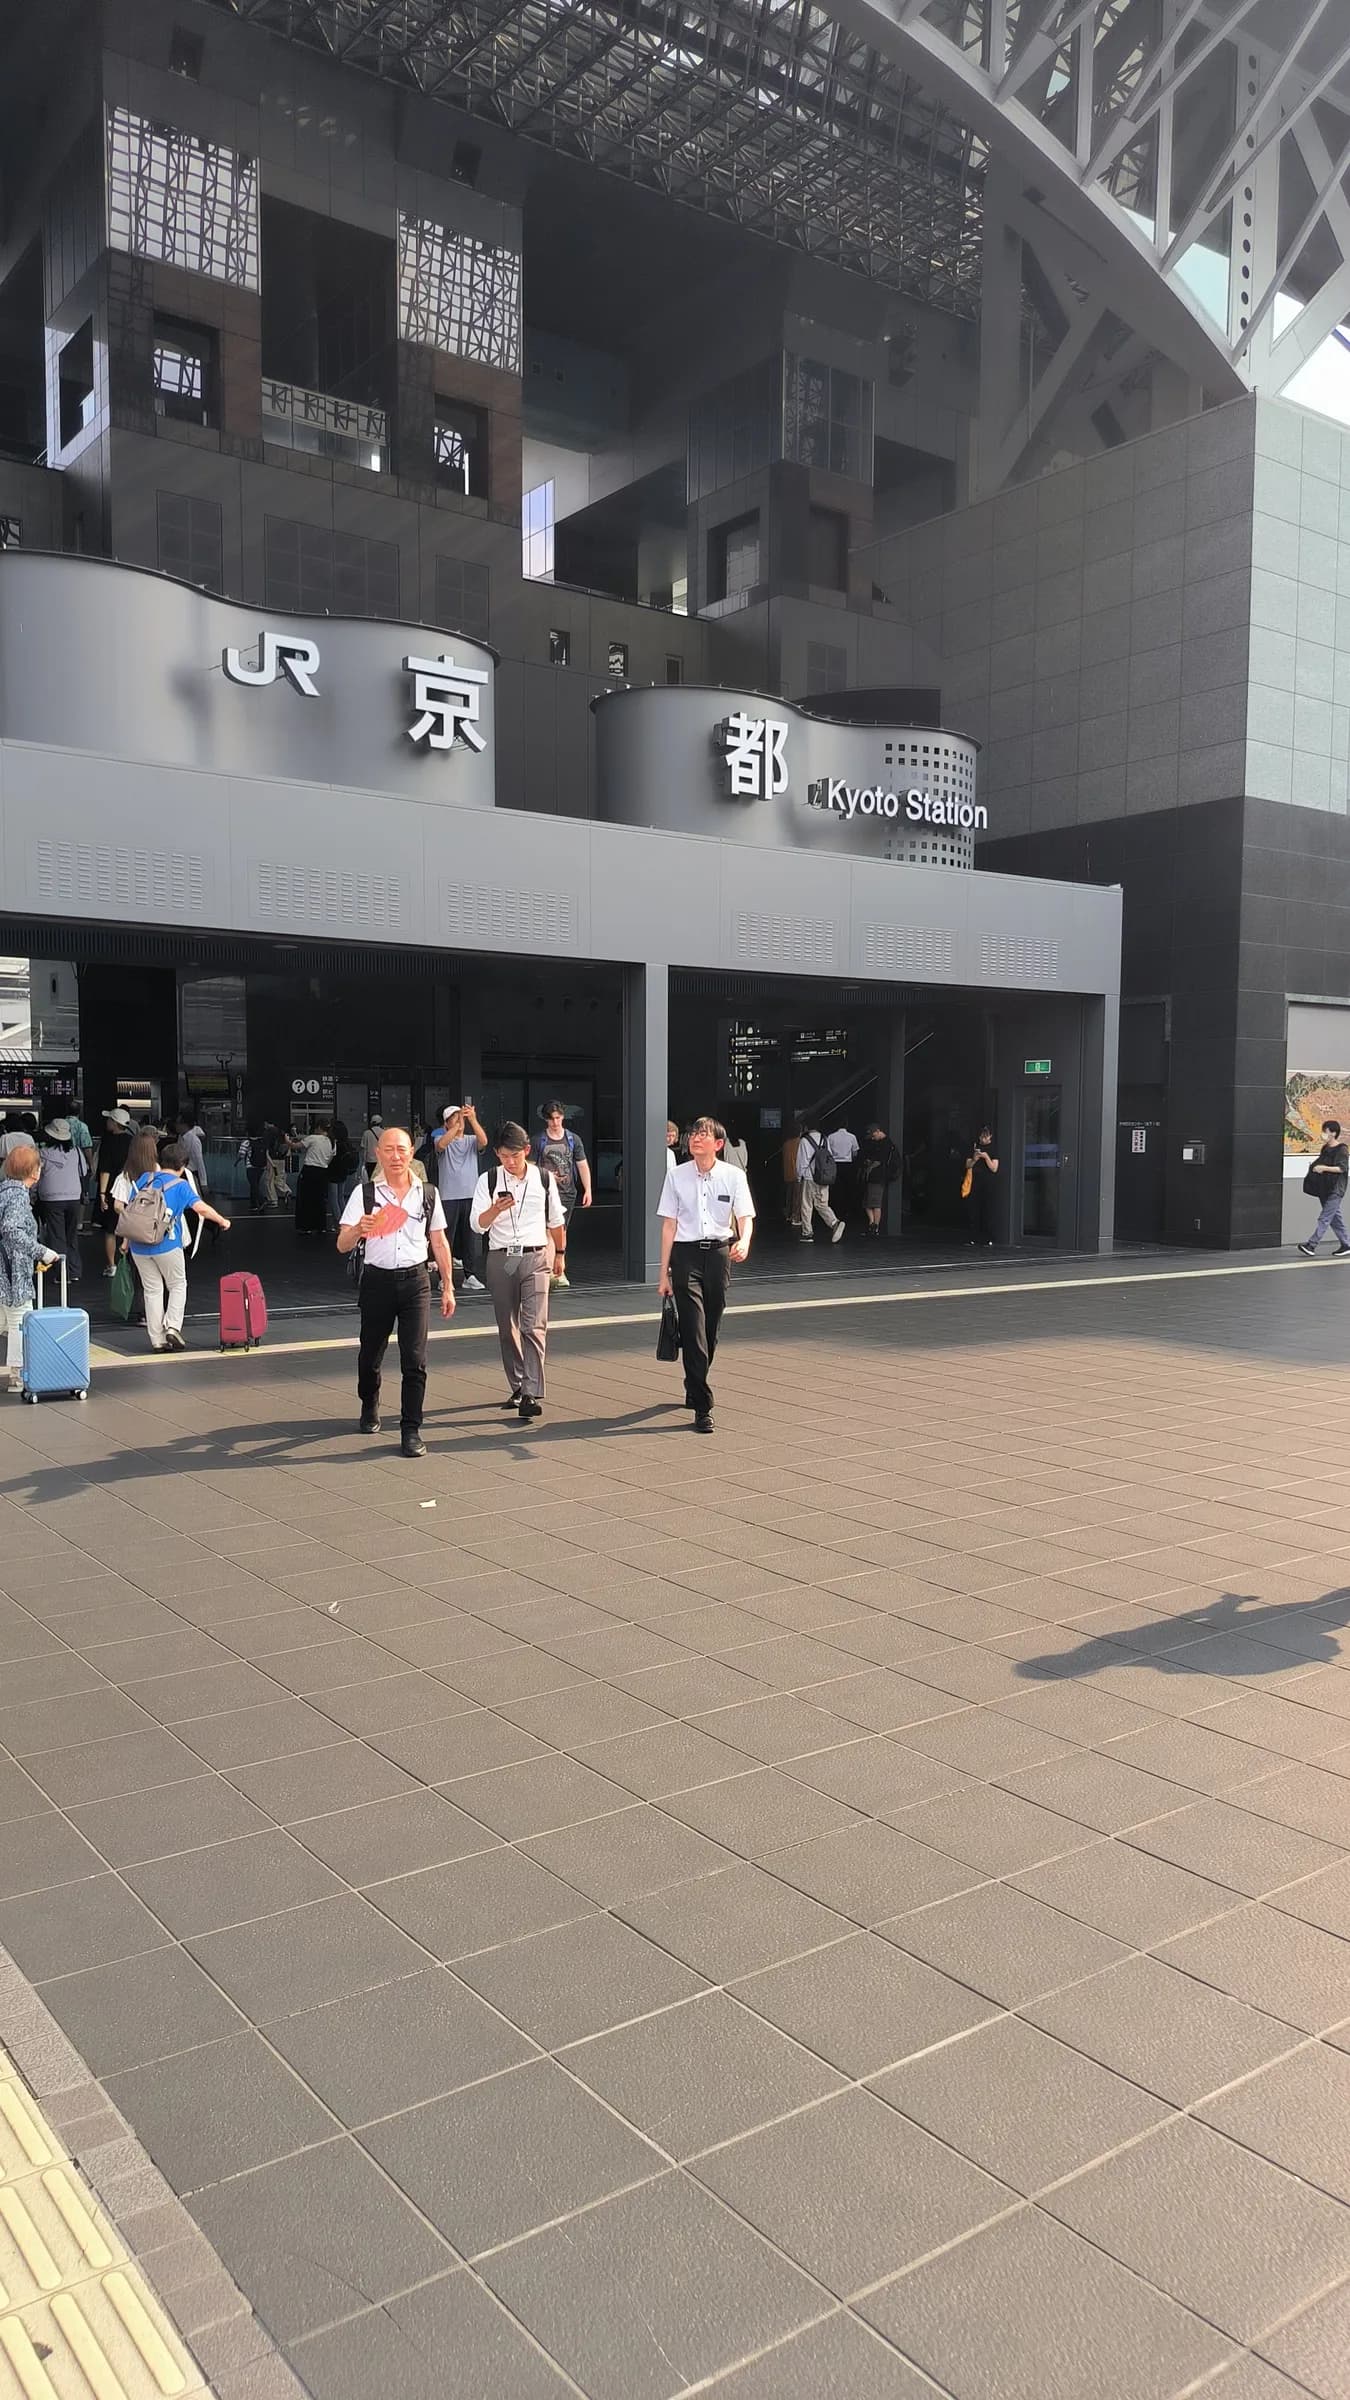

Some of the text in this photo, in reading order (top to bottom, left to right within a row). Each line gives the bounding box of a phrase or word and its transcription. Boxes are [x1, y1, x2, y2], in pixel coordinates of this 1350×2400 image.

[223, 631, 321, 697] JR
[403, 655, 789, 800] 京 都
[827, 777, 988, 830] Kyoto Station
